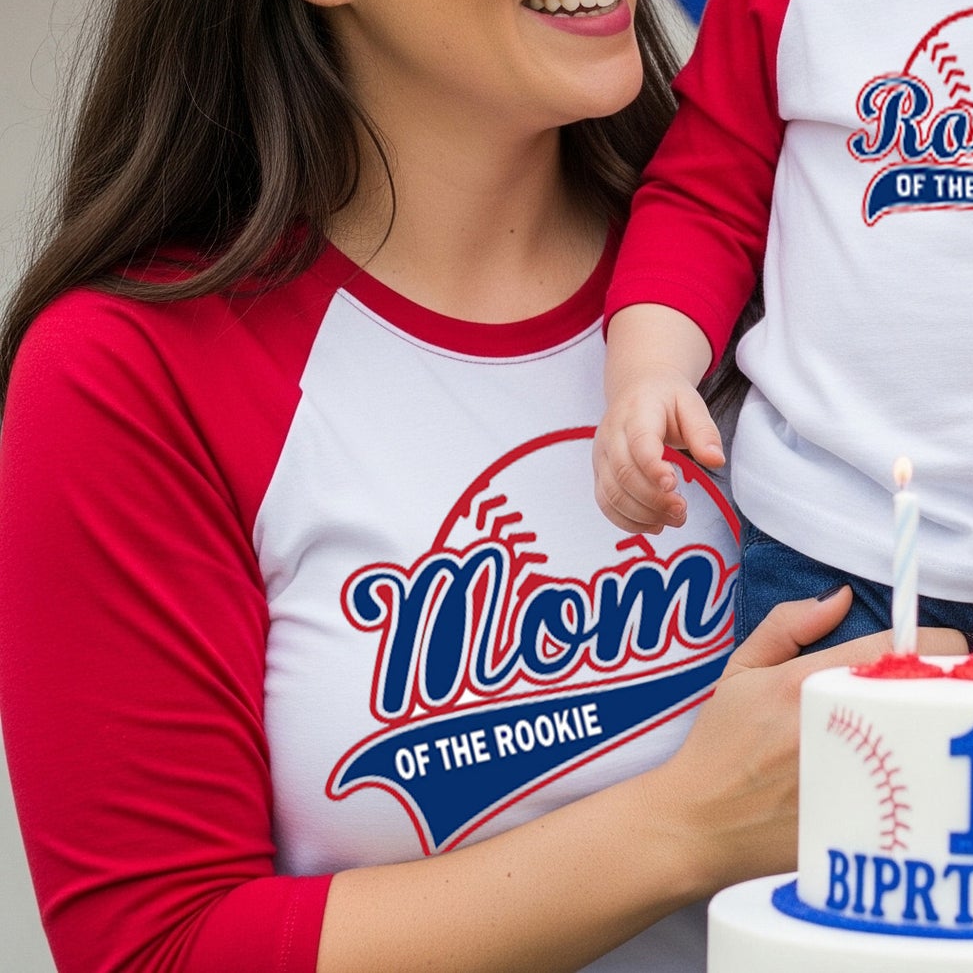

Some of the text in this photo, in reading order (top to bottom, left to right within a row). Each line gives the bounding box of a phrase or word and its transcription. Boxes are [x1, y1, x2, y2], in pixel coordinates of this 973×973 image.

[896, 174, 924, 197] OF
[348, 544, 738, 716] Mom
[394, 703, 602, 780] OF THE ROOKIE
